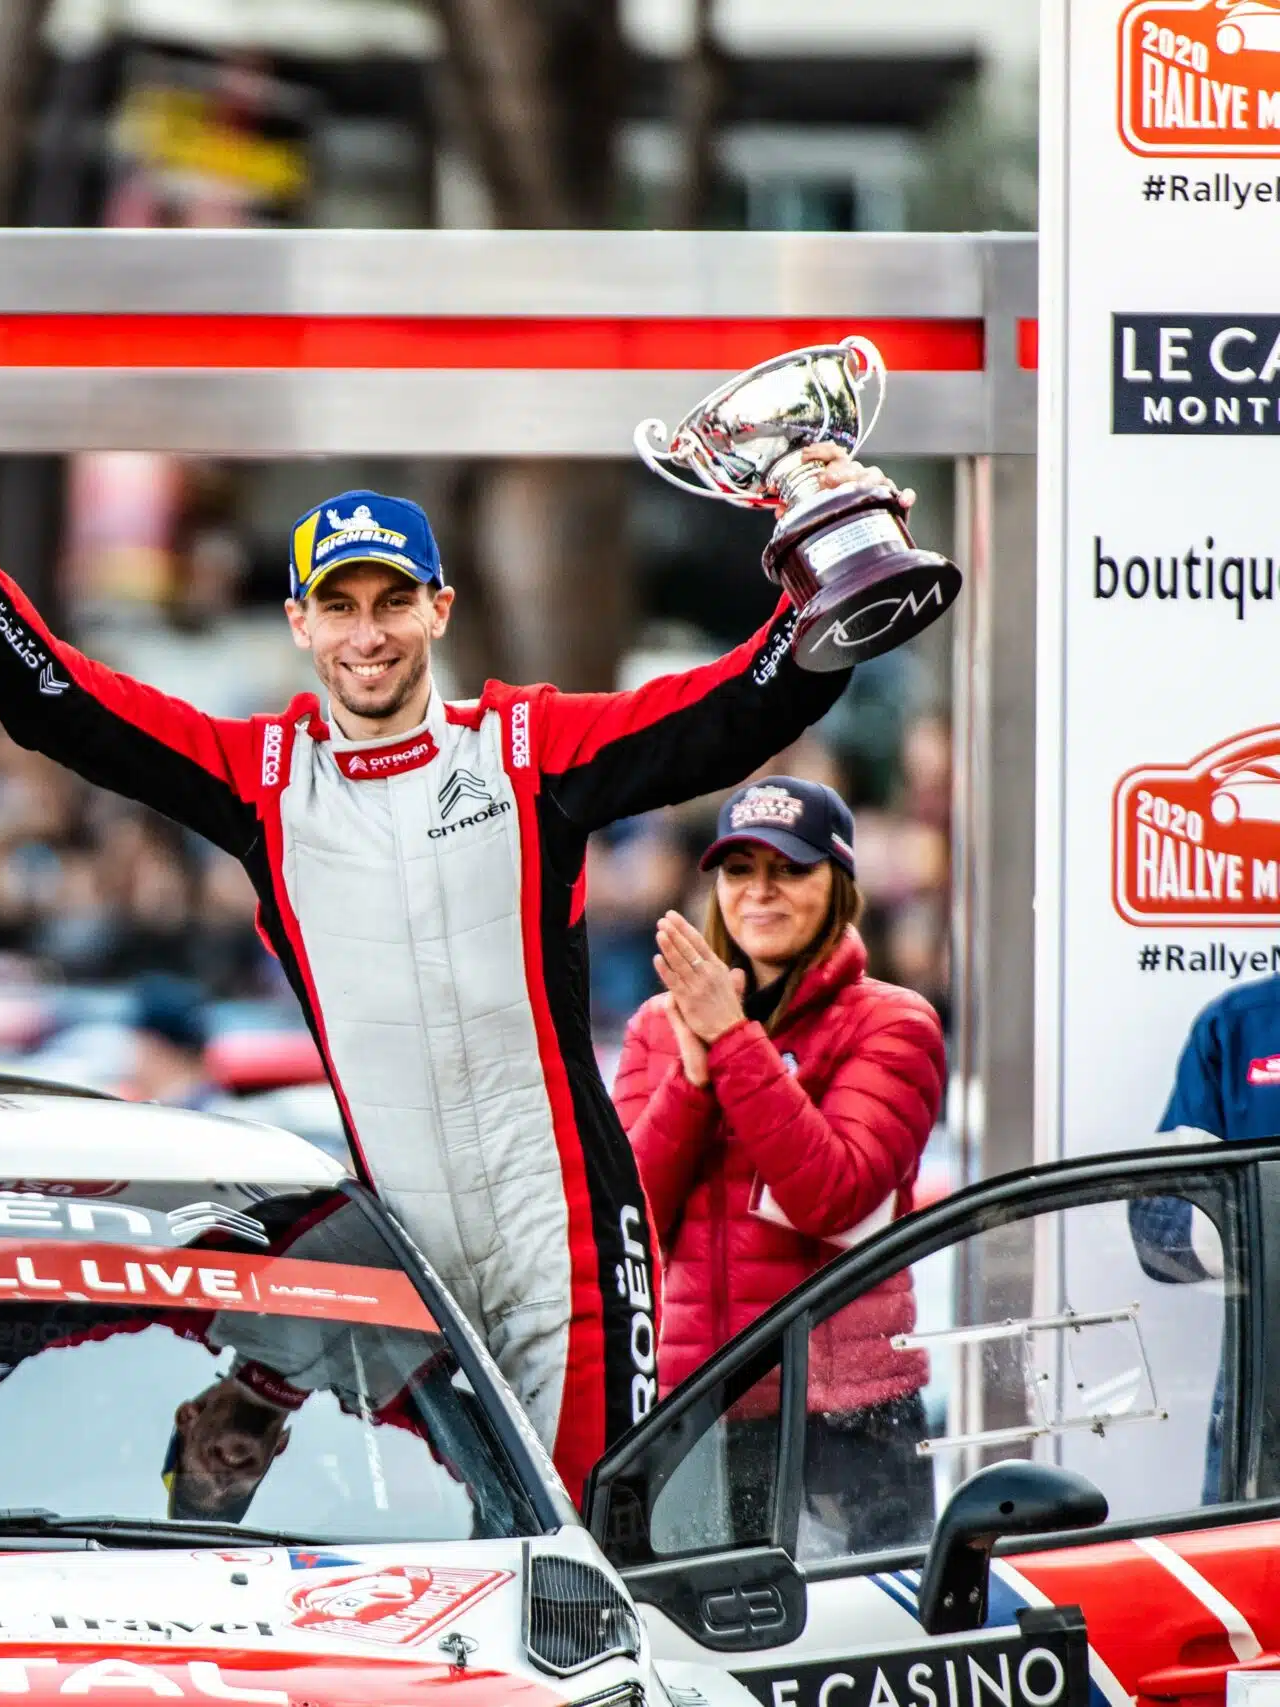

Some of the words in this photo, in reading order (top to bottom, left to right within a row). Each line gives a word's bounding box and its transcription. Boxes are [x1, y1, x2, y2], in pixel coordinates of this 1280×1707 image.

[1141, 20, 1209, 73] 2020
[1141, 52, 1249, 130] RALLYE
[1141, 173, 1280, 210] #Rallye
[1122, 326, 1193, 383] LE
[1143, 396, 1280, 425] MONT
[315, 529, 407, 561] MICHELIN
[1093, 535, 1280, 620] boutiqu
[263, 724, 283, 786] sparco
[512, 702, 530, 768] sparco
[1135, 789, 1204, 843] 2020
[1136, 820, 1244, 900] RALLYE
[81, 1258, 243, 1299] LIVE
[818, 1647, 1066, 1707] CASINO
